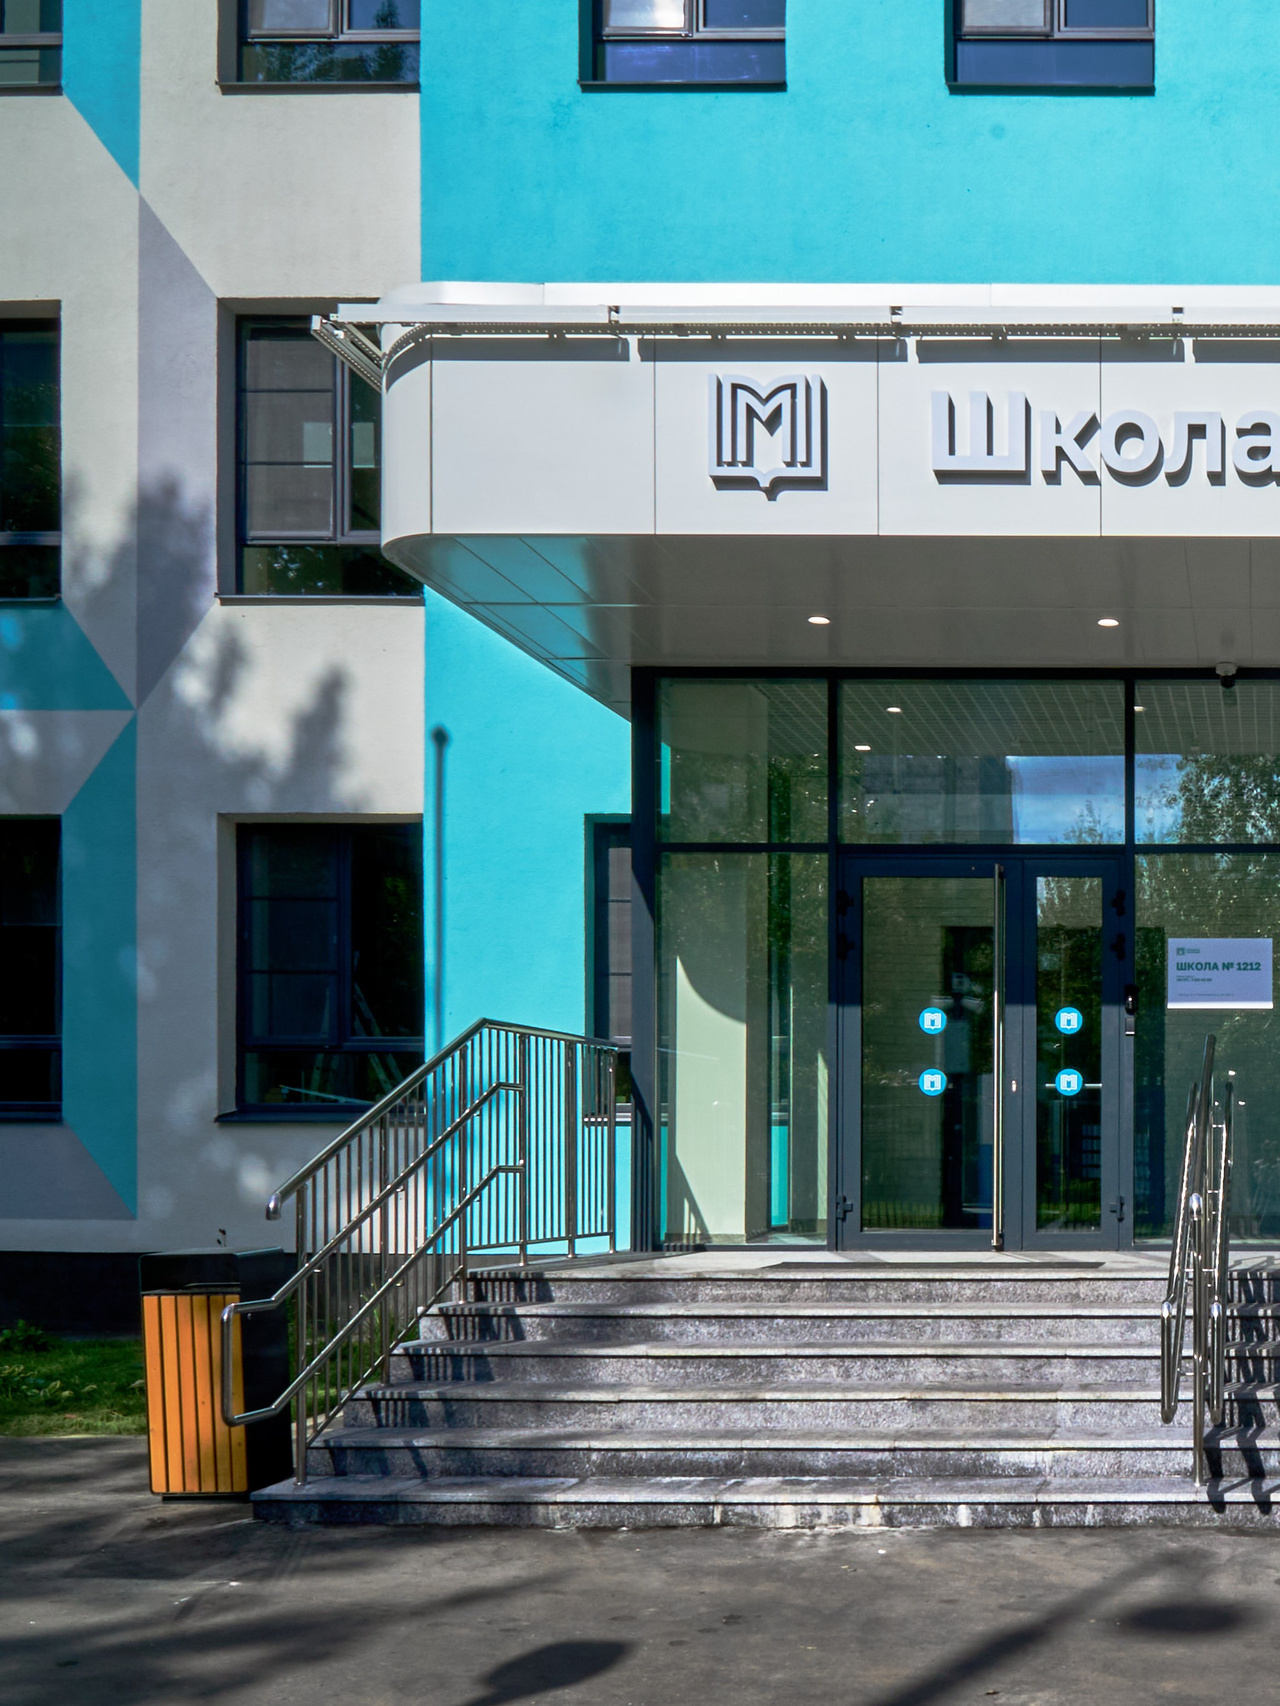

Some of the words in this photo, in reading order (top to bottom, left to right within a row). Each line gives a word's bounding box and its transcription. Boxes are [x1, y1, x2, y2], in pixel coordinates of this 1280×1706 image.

[1176, 961, 1220, 972] ШКОЛА
[1221, 961, 1235, 972] №
[1236, 961, 1262, 972] 1212
